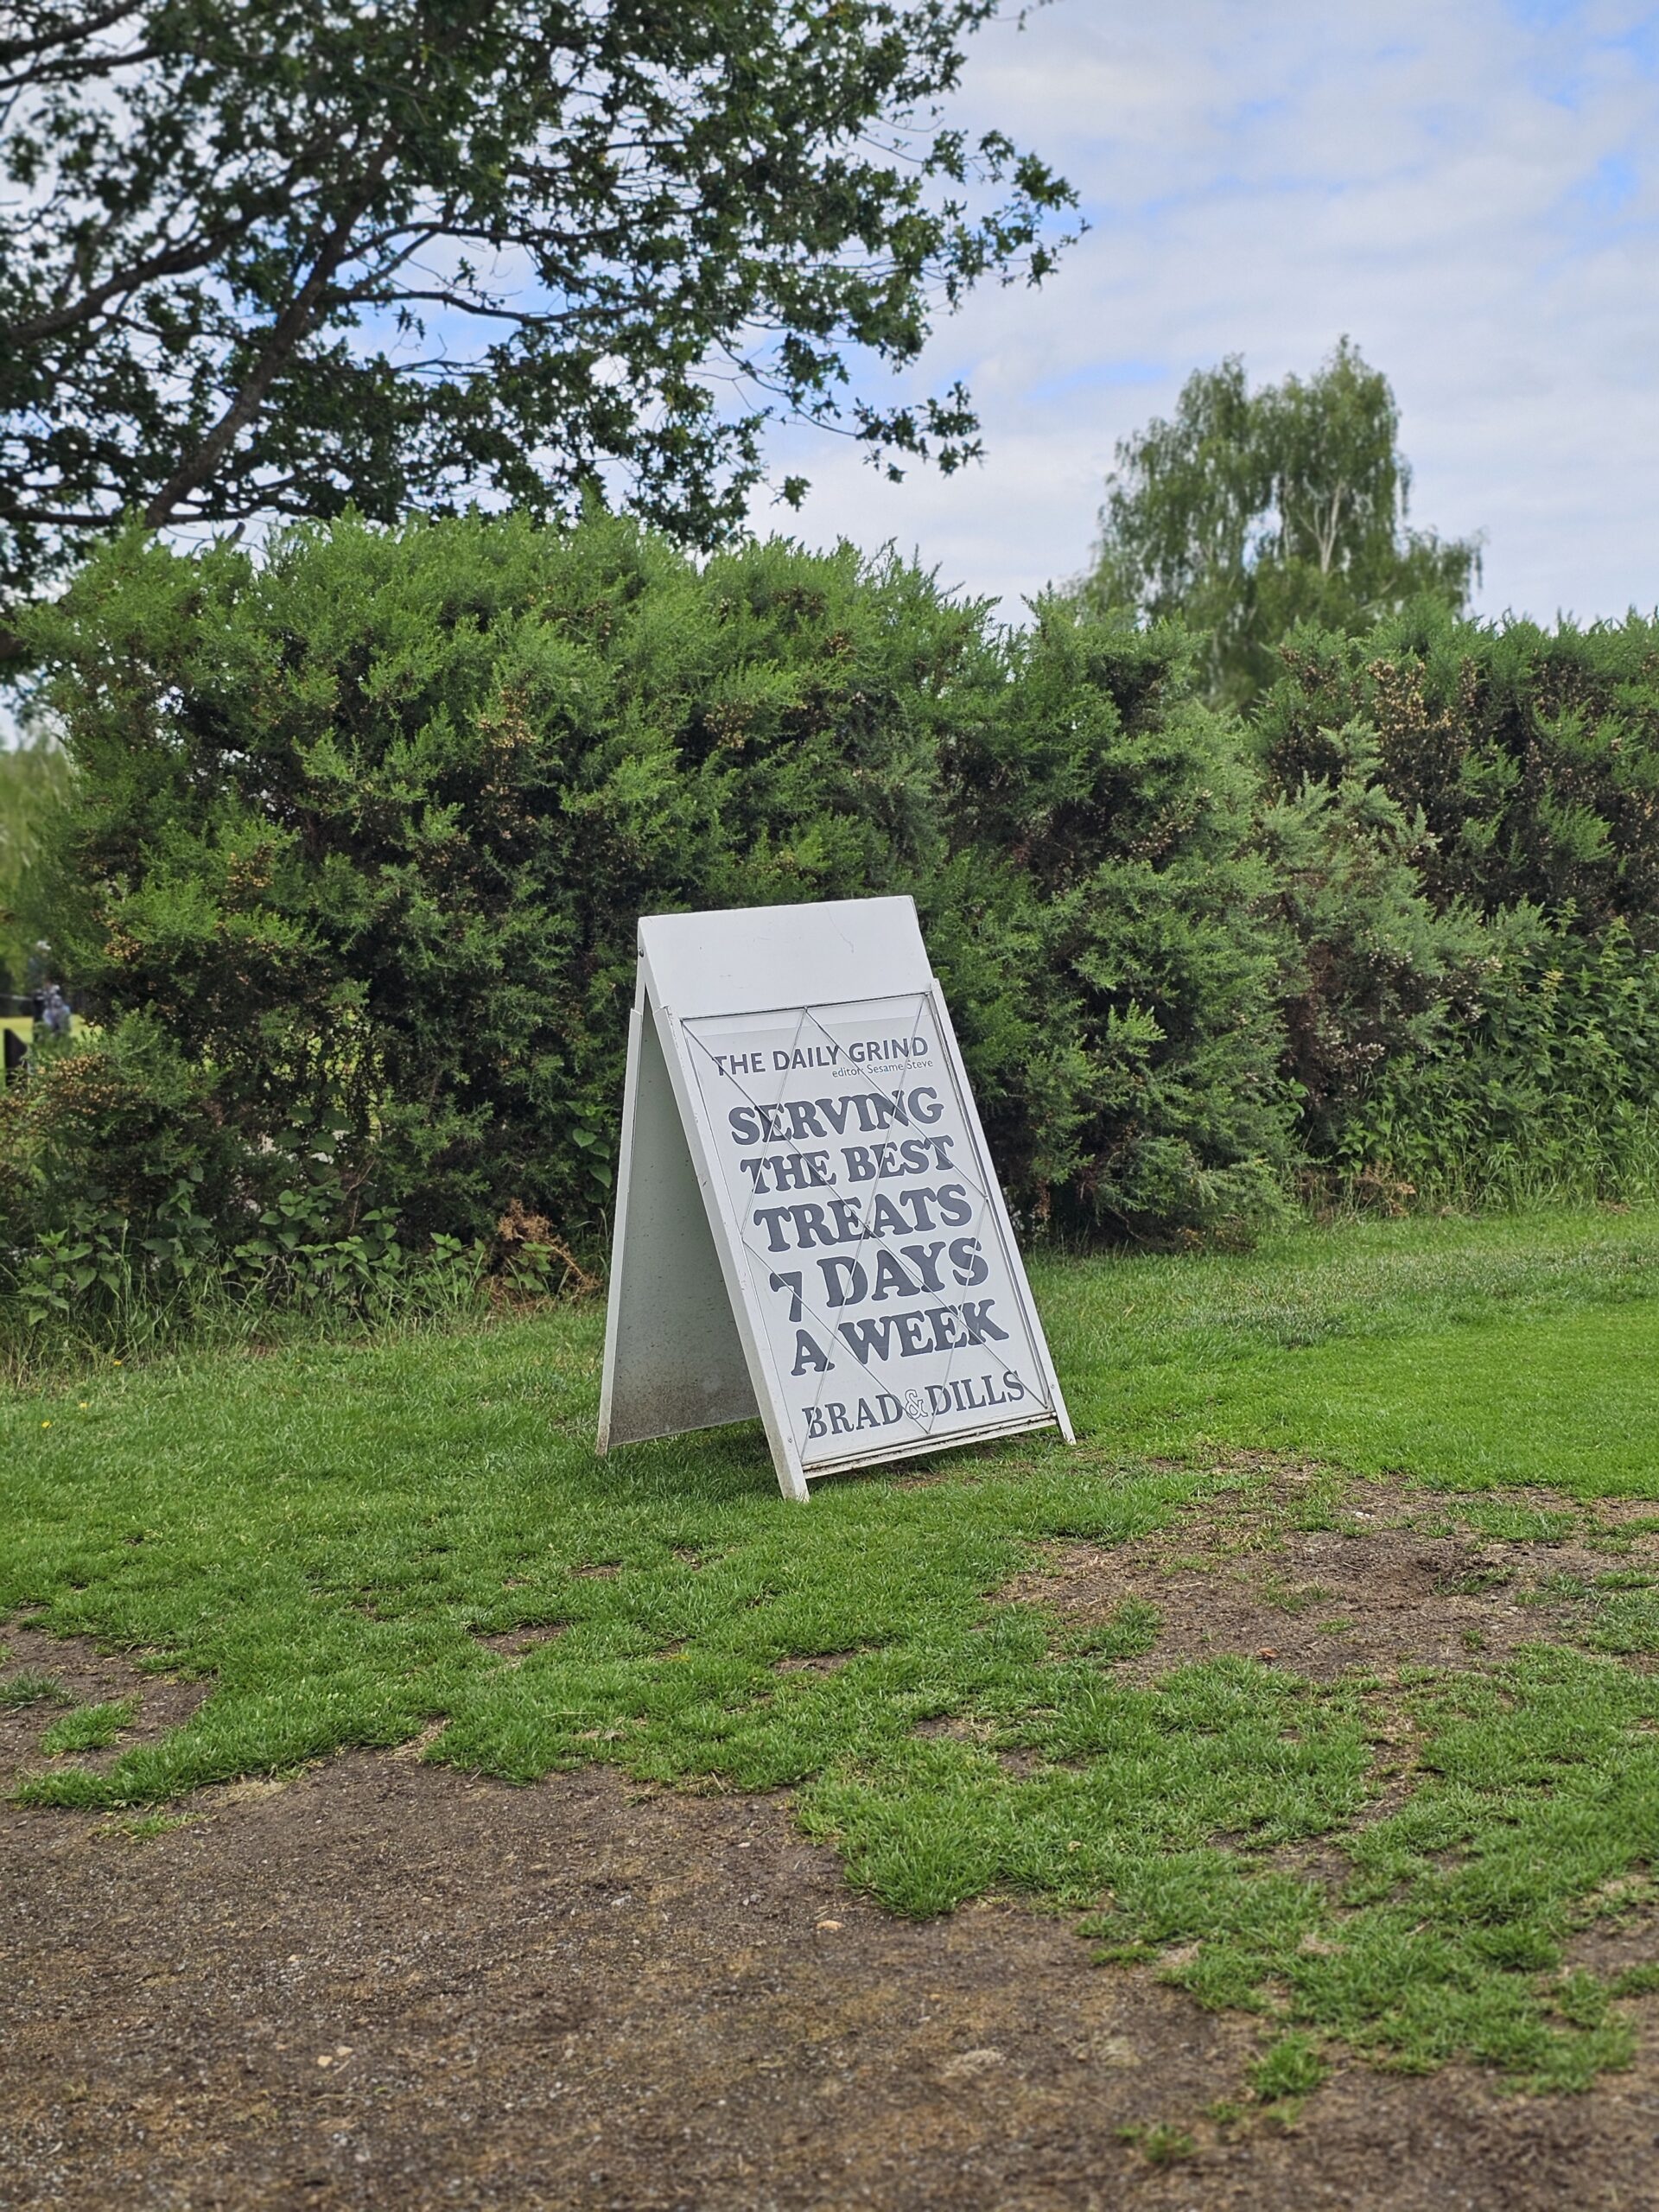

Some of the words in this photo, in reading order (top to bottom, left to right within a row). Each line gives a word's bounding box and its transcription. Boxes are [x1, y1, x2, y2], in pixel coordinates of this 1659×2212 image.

[713, 1052, 766, 1076] THE
[773, 1045, 839, 1071] DAILY
[849, 1036, 928, 1063] GRIND
[867, 1063, 904, 1074] Sesame
[906, 1058, 933, 1070] Steve
[728, 1087, 944, 1145] SERVING
[740, 1149, 837, 1194] THE
[840, 1134, 955, 1183] BEST
[753, 1184, 973, 1253] TREATS
[769, 1270, 803, 1323] 7
[817, 1236, 988, 1307] DAYS
[791, 1329, 836, 1376] A
[838, 1299, 1010, 1365] WEEK
